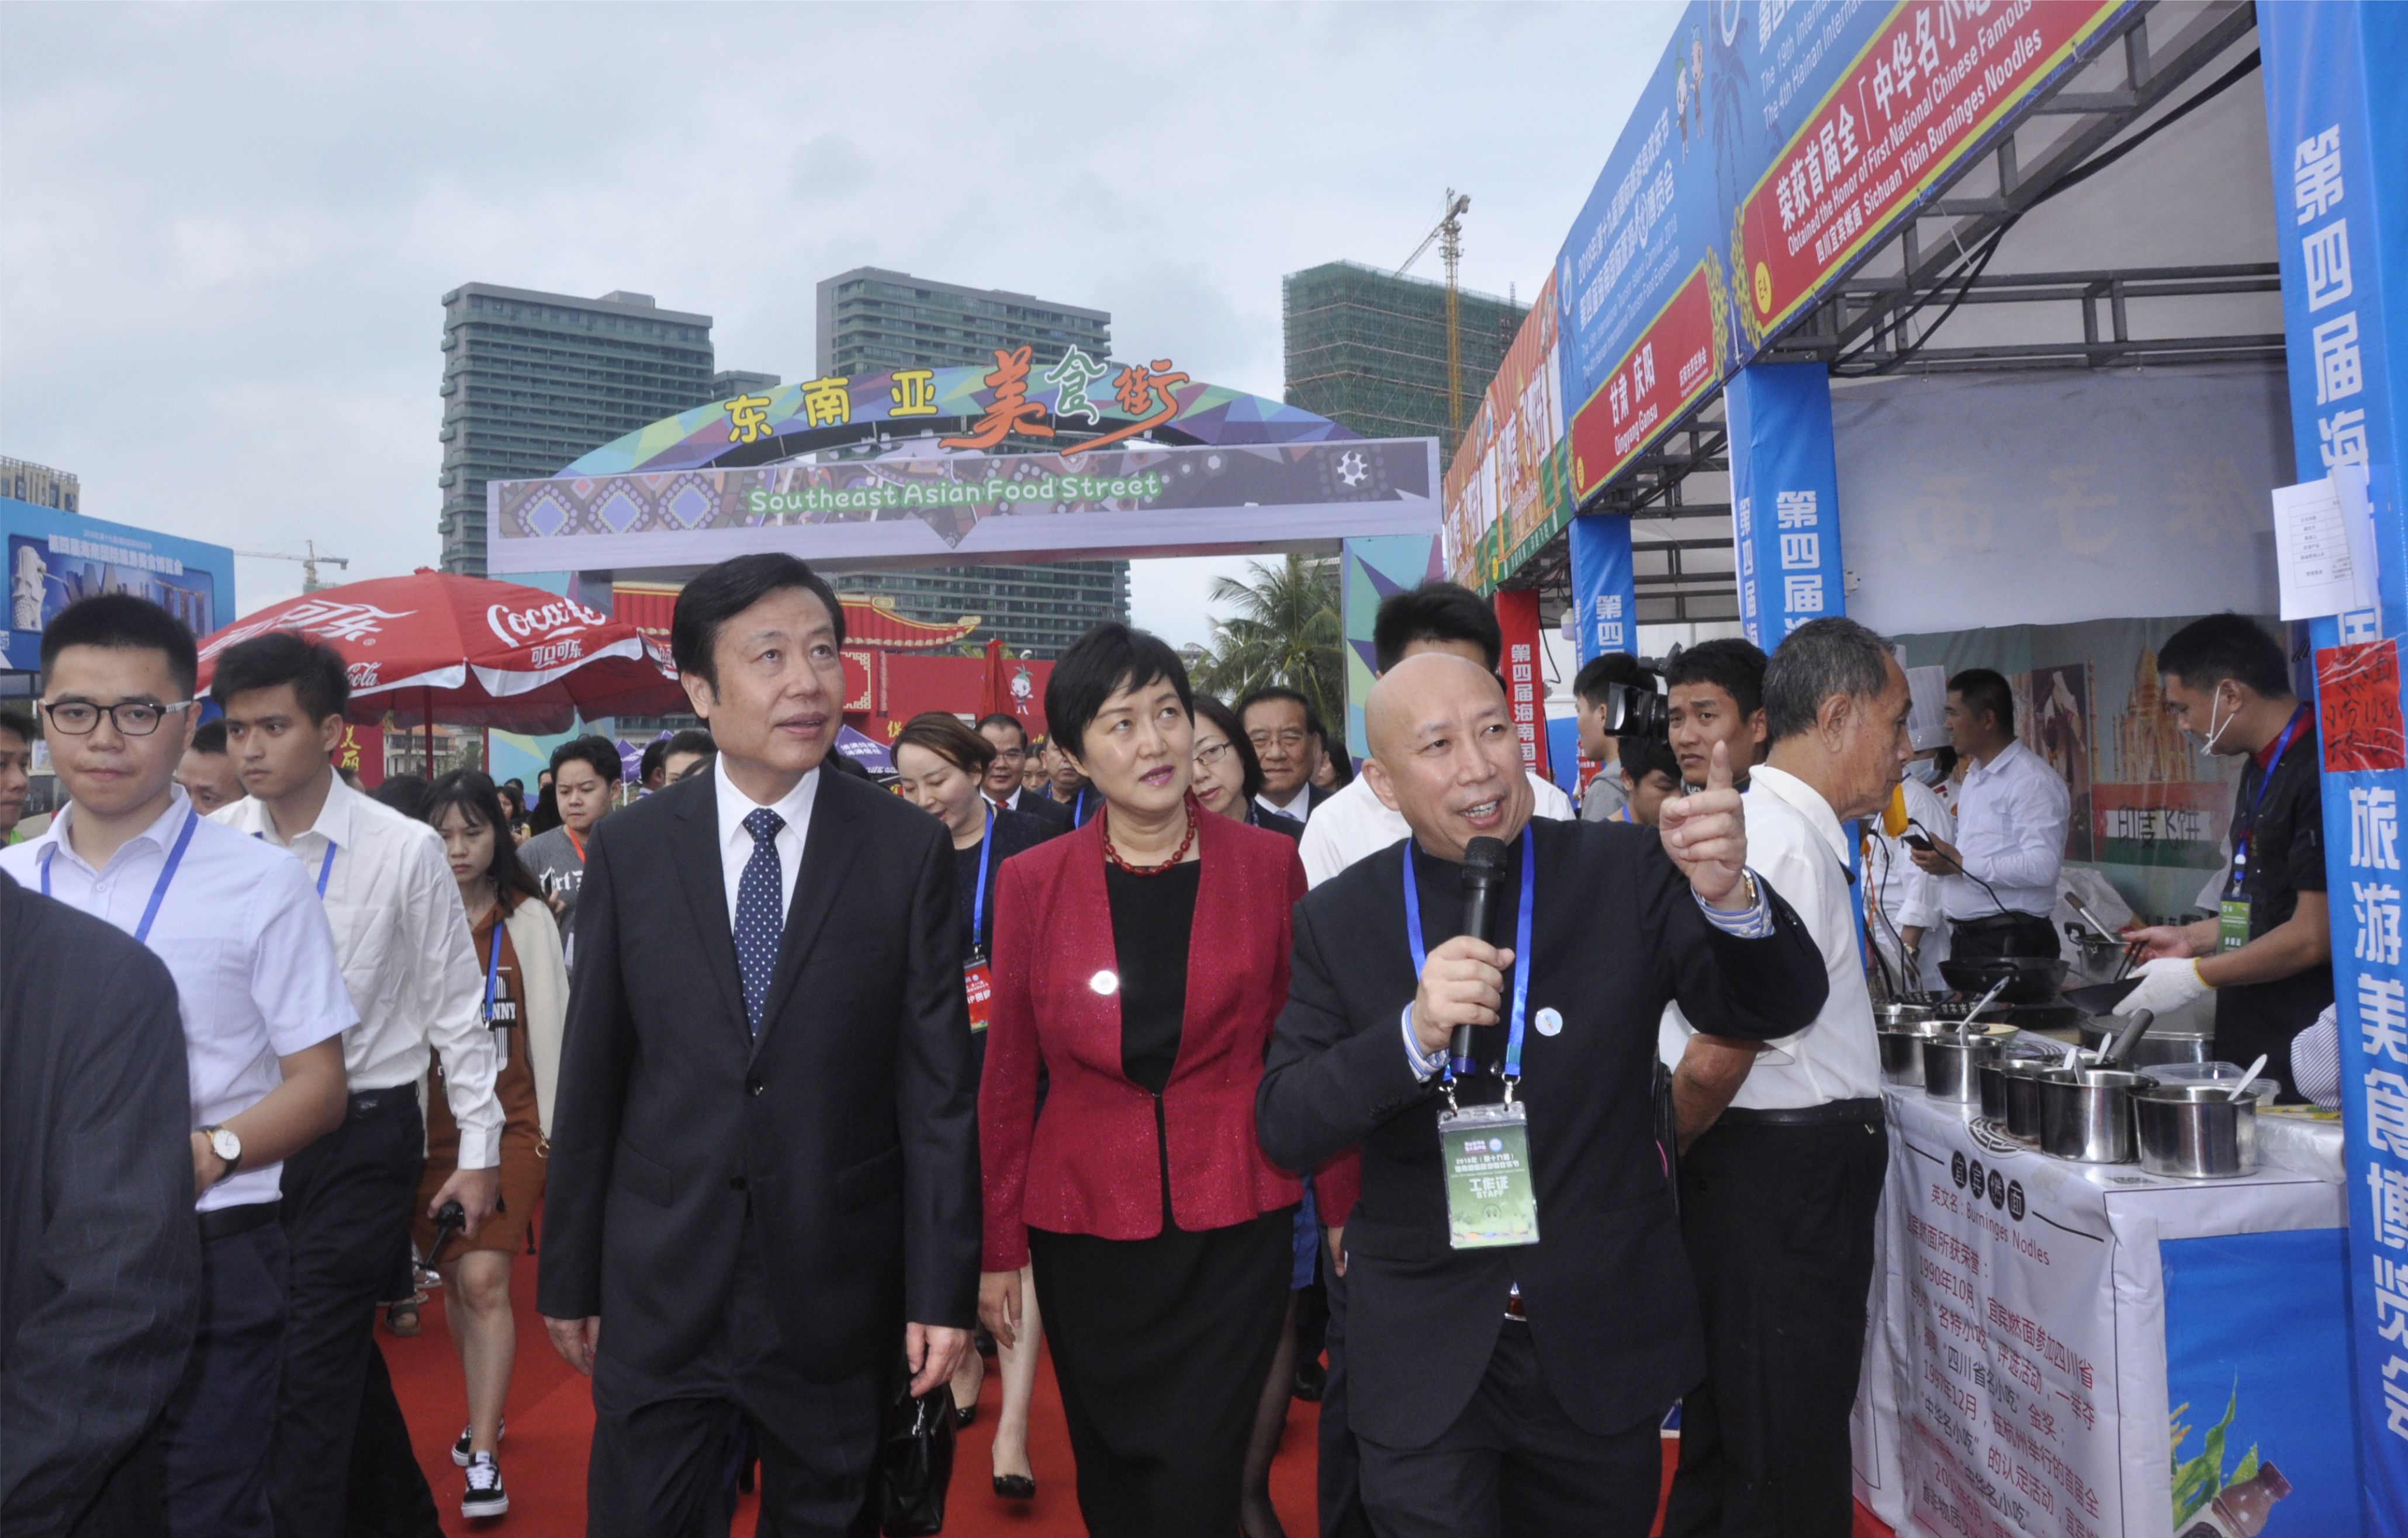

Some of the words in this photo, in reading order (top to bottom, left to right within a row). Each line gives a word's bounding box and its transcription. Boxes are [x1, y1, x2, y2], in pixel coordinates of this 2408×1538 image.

[1761, 65, 1775, 96] The
[1777, 34, 1794, 72] 19th
[1796, 0, 1830, 46] Interna
[1763, 103, 1779, 130] The
[1779, 82, 1793, 110] 4th
[1792, 39, 1823, 92] Hainan
[1823, 0, 1863, 51] Interna
[1788, 218, 1821, 257] Obtained
[1819, 201, 1834, 224] the
[1832, 175, 1858, 213] Honor
[1859, 159, 1869, 183] of
[1868, 135, 1891, 174] First
[1888, 87, 1934, 152] National
[1932, 45, 1978, 104] Chinese
[1977, 0, 2032, 57] Famous
[1863, 168, 1903, 216] Sichuan
[1900, 141, 1929, 178] Yibin
[1927, 84, 1985, 153] Burninges
[1984, 28, 2042, 98] Noodles
[1758, 275, 1768, 300] E4
[724, 369, 938, 445] 东南亚
[939, 344, 1189, 457] 美食街
[1610, 372, 1629, 428] 甘肃
[1634, 341, 1656, 404] 庆阳
[1615, 421, 1640, 457] Qingyang
[1638, 402, 1658, 432] Gansu
[750, 483, 897, 513] Southeast
[904, 481, 980, 506] Asian
[987, 478, 1053, 502] Food
[1061, 472, 1161, 498] Street
[531, 638, 583, 669] 可口可乐
[1596, 595, 1625, 656] 第四
[1469, 1176, 1509, 1192] 工作证
[1476, 1189, 1504, 1199] STAFF
[1966, 1202, 2009, 1243] Burninges
[2012, 1229, 2050, 1266] Nodles
